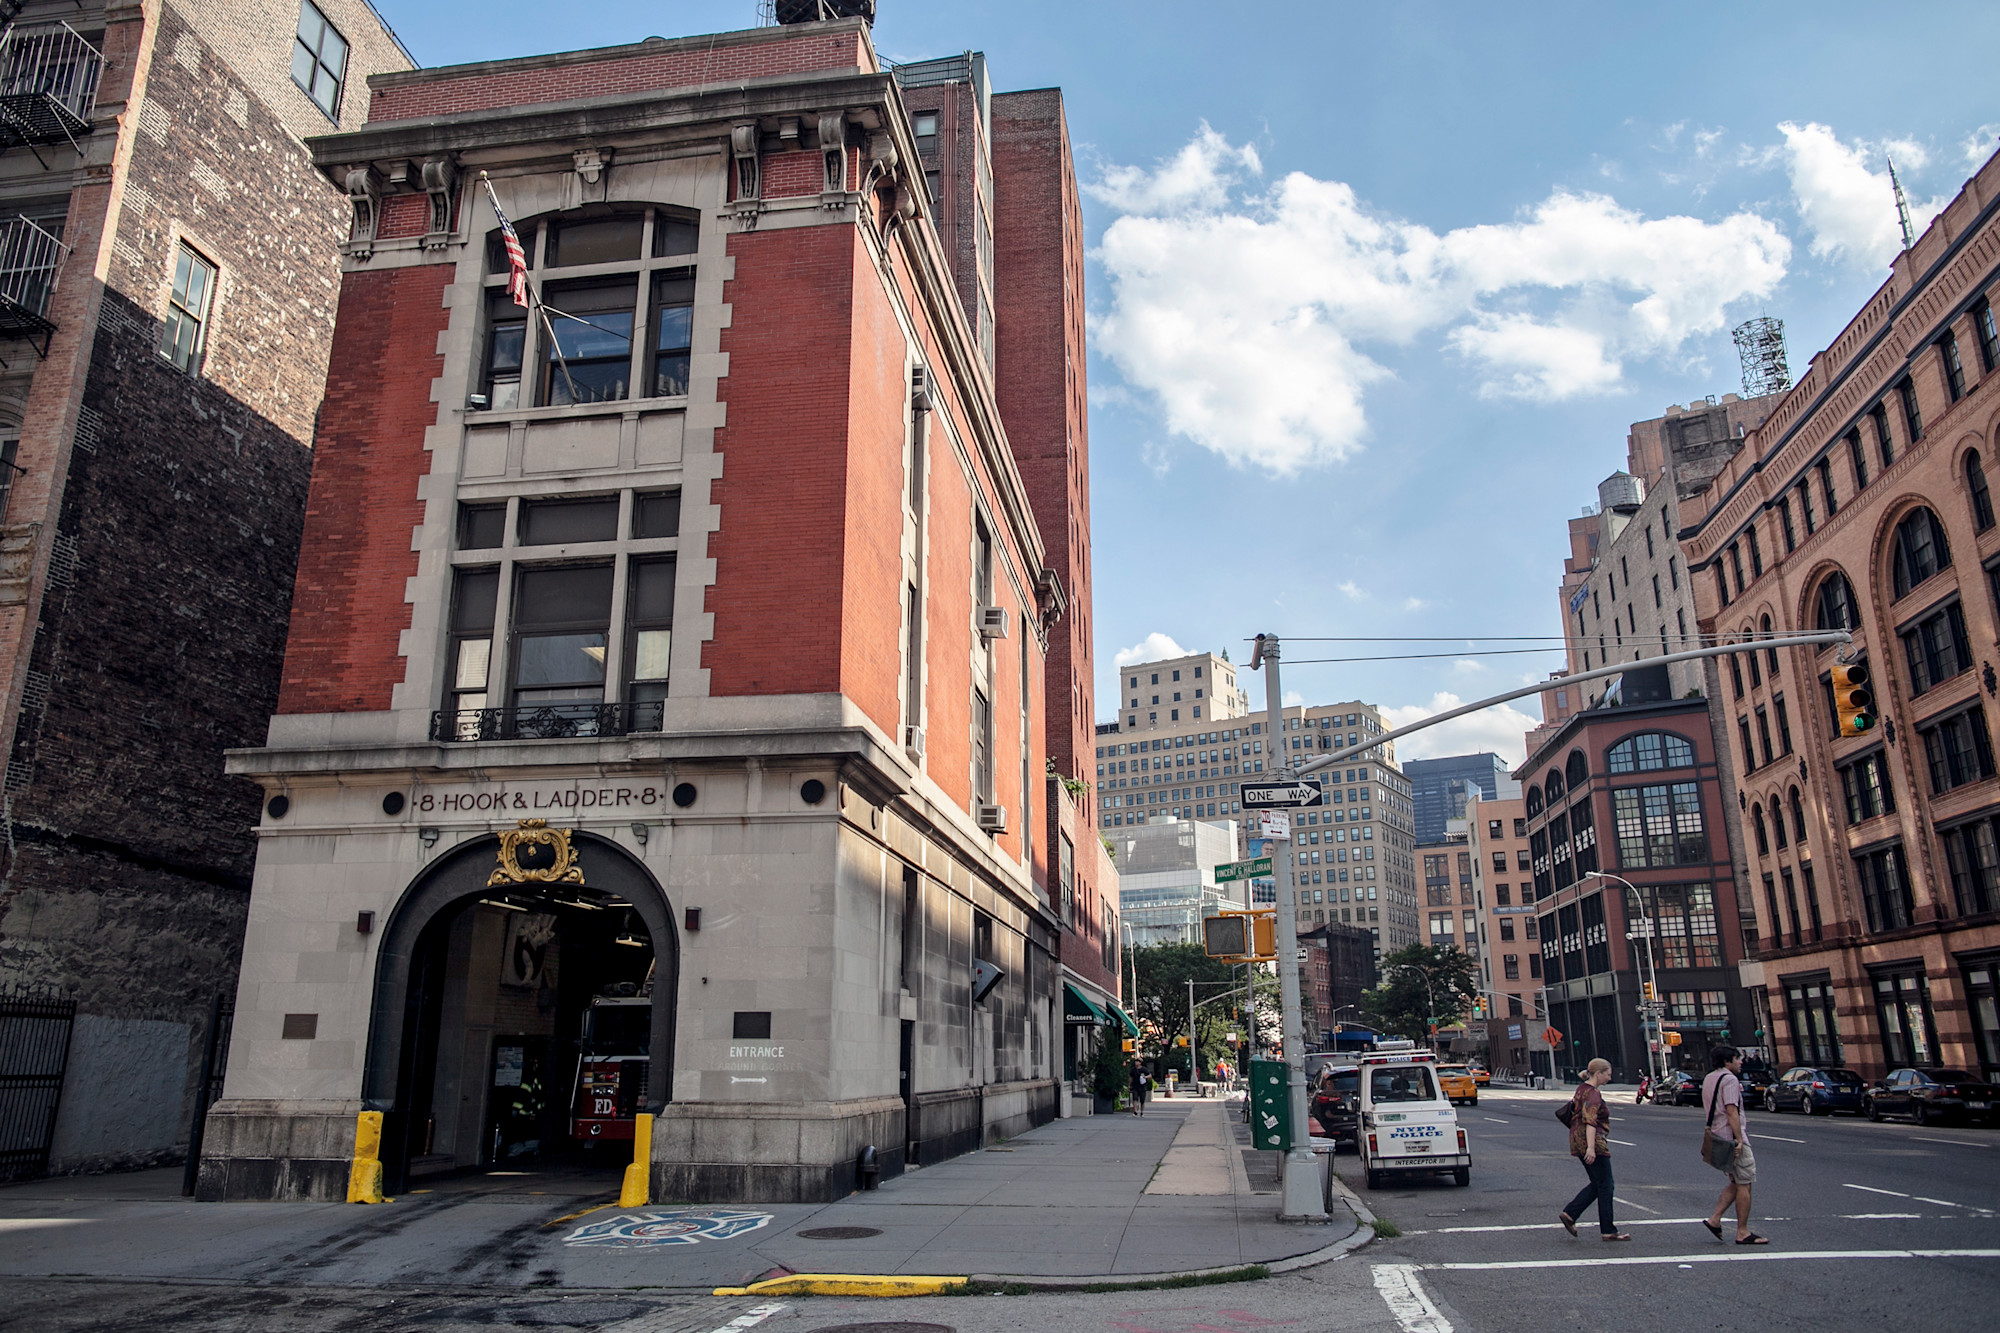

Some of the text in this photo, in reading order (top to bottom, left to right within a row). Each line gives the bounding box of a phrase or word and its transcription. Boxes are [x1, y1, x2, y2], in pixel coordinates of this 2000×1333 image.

[443, 792, 509, 811] HOOK
[513, 792, 528, 809] &
[533, 788, 632, 809] LADDER
[1248, 789, 1312, 801] ONE WAY
[1262, 812, 1270, 822] NO
[1216, 868, 1236, 878] VINCENT
[1243, 862, 1271, 874] HALLORAN
[729, 1046, 785, 1058] ENTRANCE
[1390, 1131, 1443, 1139] POLICE
[1394, 1158, 1438, 1166] INTERCEPTOR
